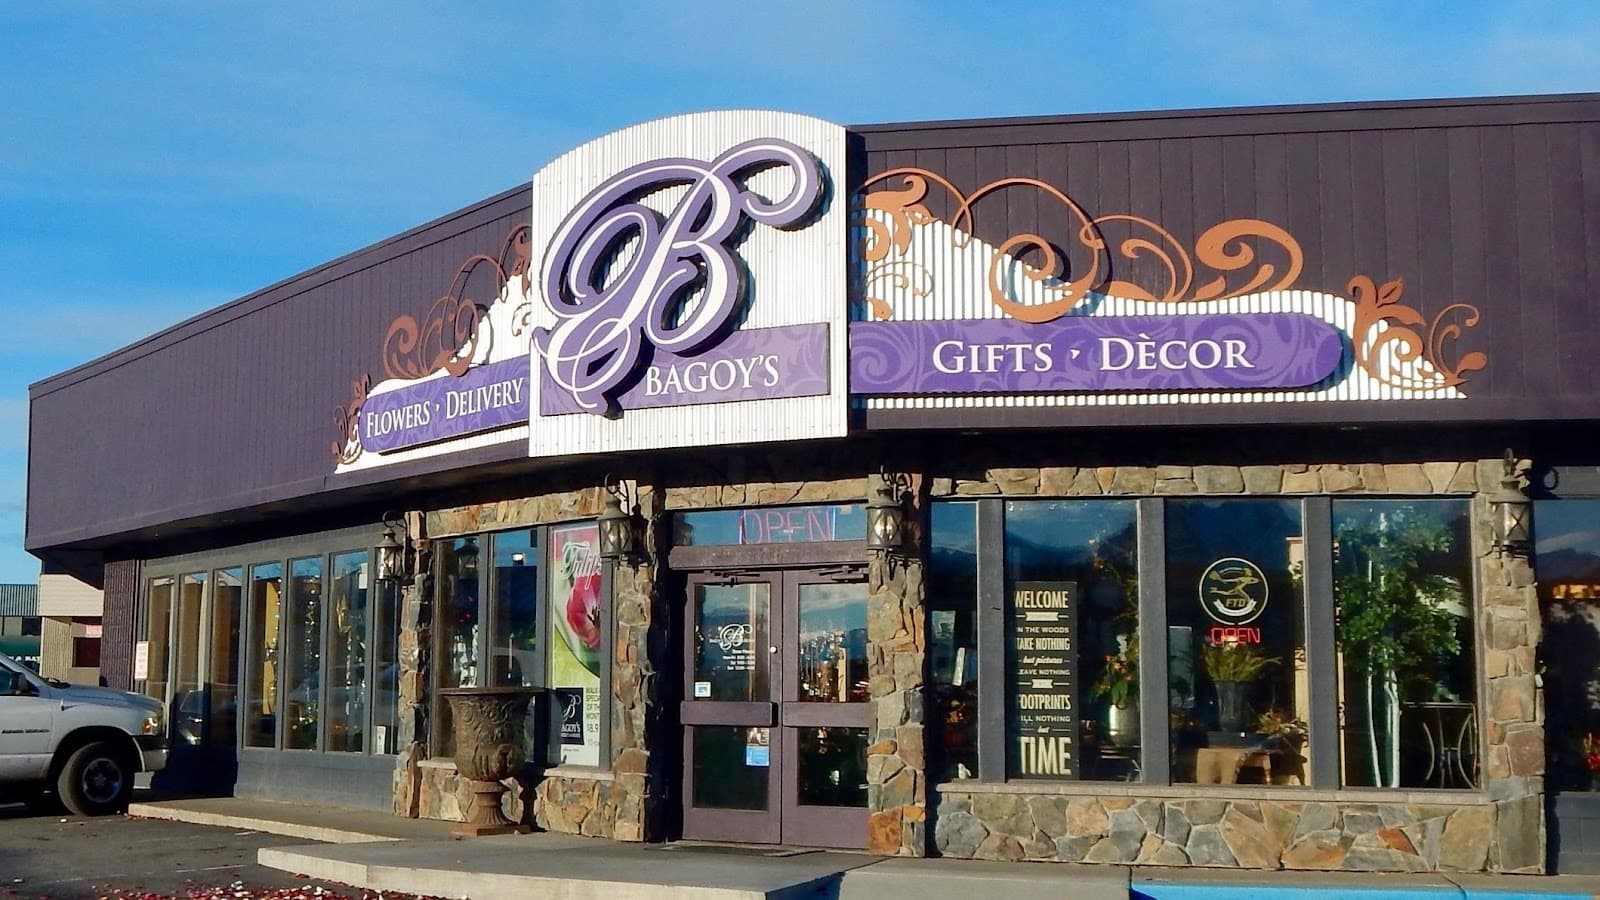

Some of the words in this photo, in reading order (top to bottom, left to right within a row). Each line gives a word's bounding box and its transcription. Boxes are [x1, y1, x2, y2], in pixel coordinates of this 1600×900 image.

[533, 142, 812, 411] B
[932, 340, 1053, 374] GIFTS
[1098, 333, 1255, 371] DÈCOR
[645, 354, 780, 396] BAGOY'S
[365, 400, 431, 438] FLOWERS
[446, 377, 524, 419] DELIVERY
[741, 508, 833, 545] OPEN
[1226, 599, 1246, 608] FTD
[1035, 637, 1071, 651] NOTHING
[1211, 627, 1260, 645] OPEN
[1020, 736, 1072, 775] TIME
